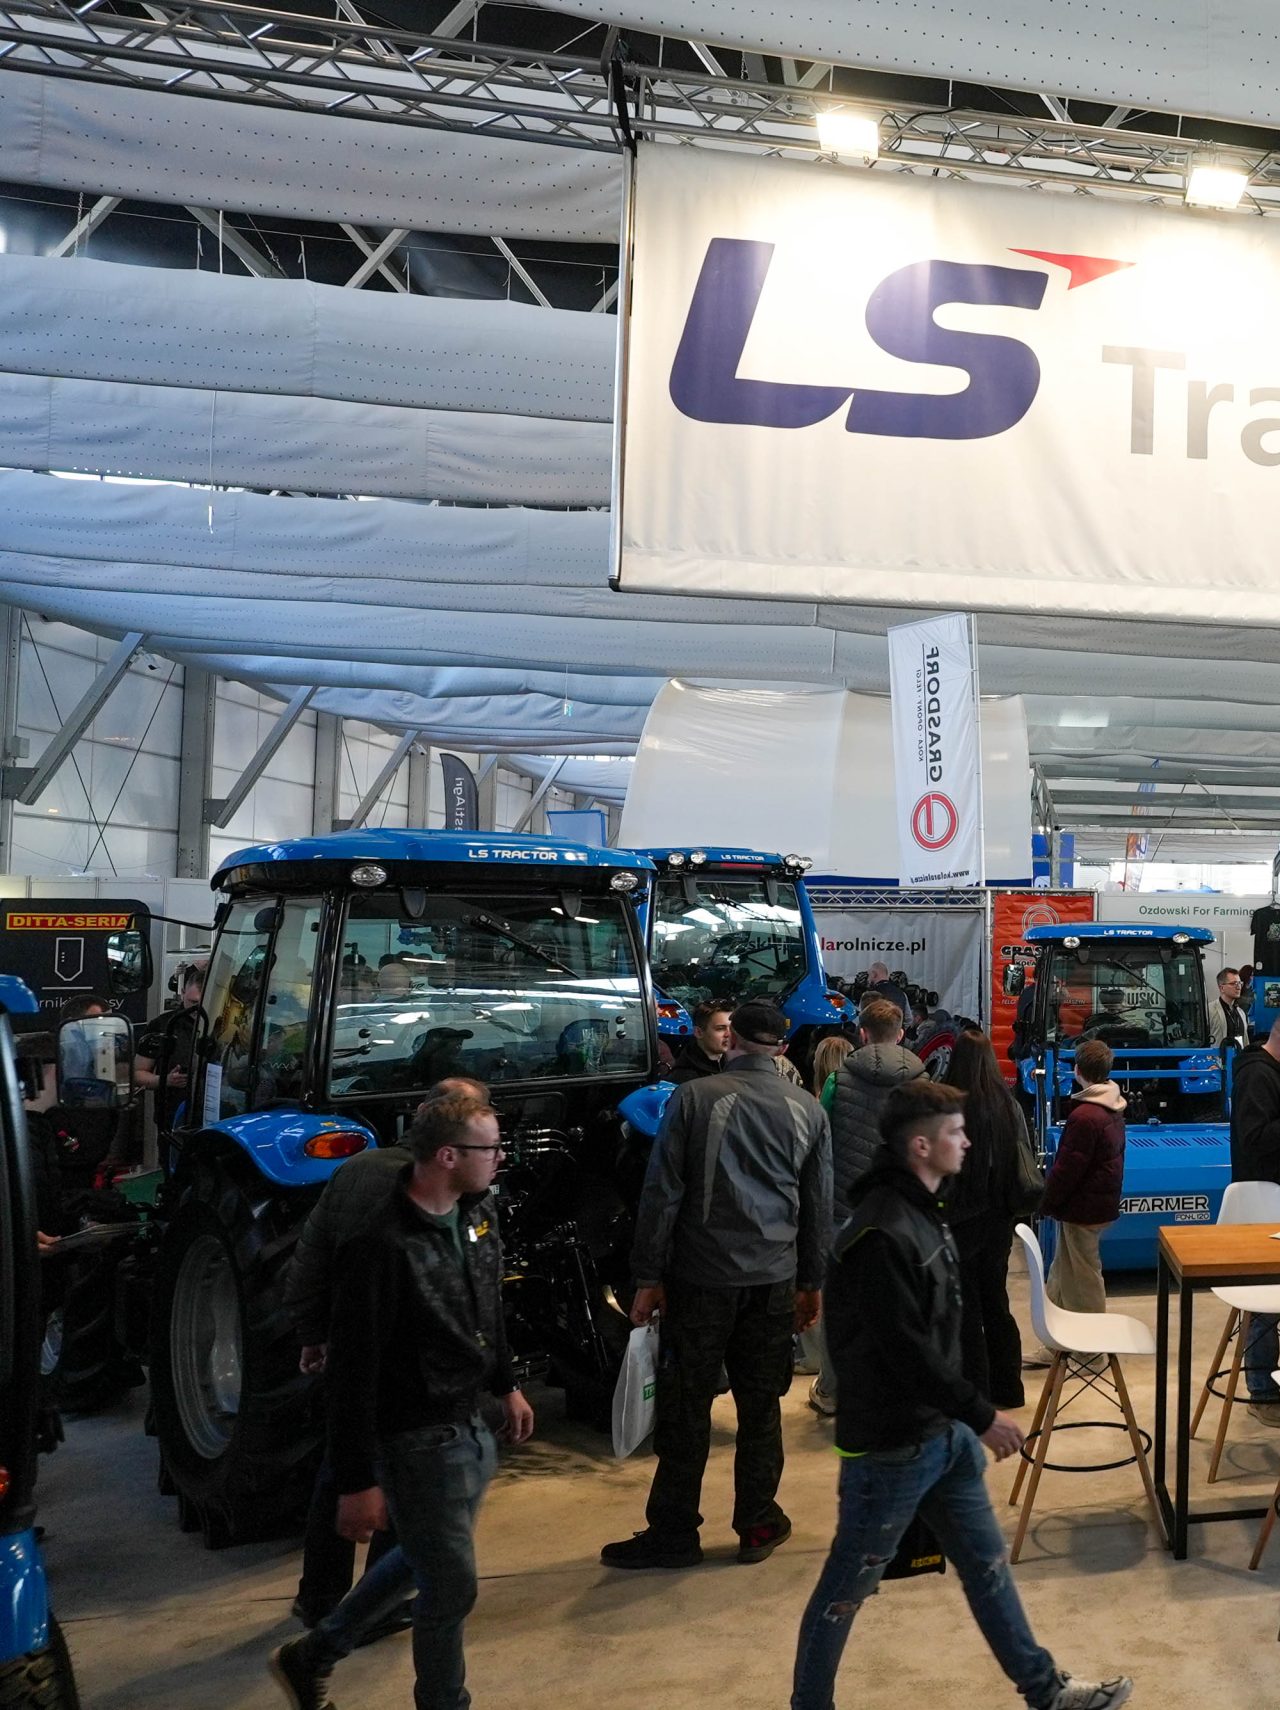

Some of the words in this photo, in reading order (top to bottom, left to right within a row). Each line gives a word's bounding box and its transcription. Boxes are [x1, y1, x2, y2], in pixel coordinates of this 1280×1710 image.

[669, 238, 1049, 440] LS
[469, 849, 489, 859] LS
[492, 849, 558, 861] TRACTOR
[1139, 905, 1190, 915] Ozdowski
[1193, 906, 1211, 916] For
[1213, 906, 1255, 918] Farming
[13, 916, 129, 927] DITTA-SERIA
[821, 938, 926, 955] larolnicze.pl
[1001, 944, 1043, 957] GRAS
[1118, 1196, 1208, 1213] AFARMER
